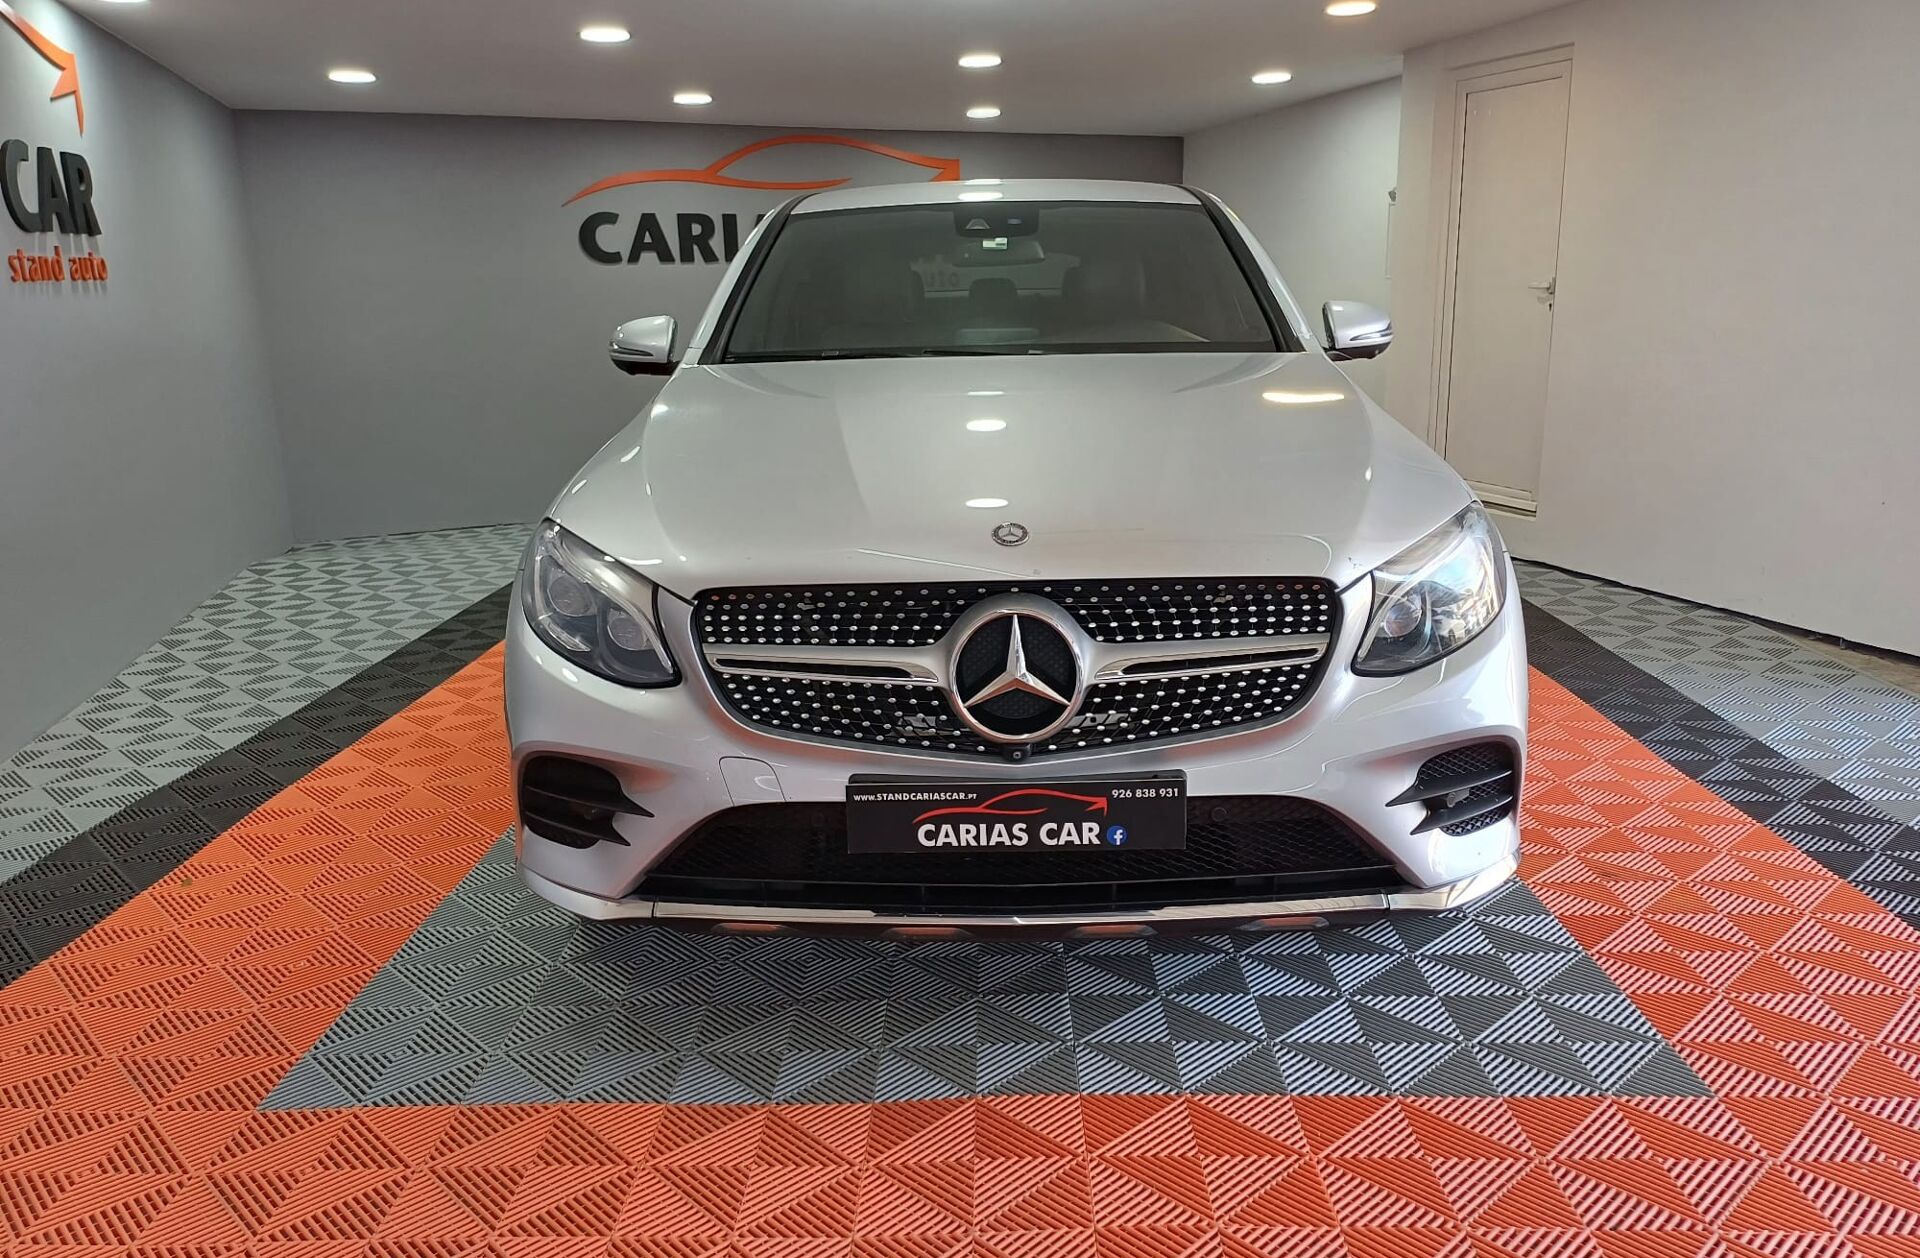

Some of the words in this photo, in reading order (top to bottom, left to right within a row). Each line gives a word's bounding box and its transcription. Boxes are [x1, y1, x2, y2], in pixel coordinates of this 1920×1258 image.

[0, 139, 102, 236] CAR
[578, 211, 767, 265] CARI
[8, 246, 65, 282] stand
[69, 252, 108, 281] auto
[1112, 789, 1132, 798] 926
[1135, 788, 1156, 797] 838
[1159, 787, 1179, 797] 931
[917, 823, 1029, 847] CARIAS
[1039, 822, 1101, 846] CAR
